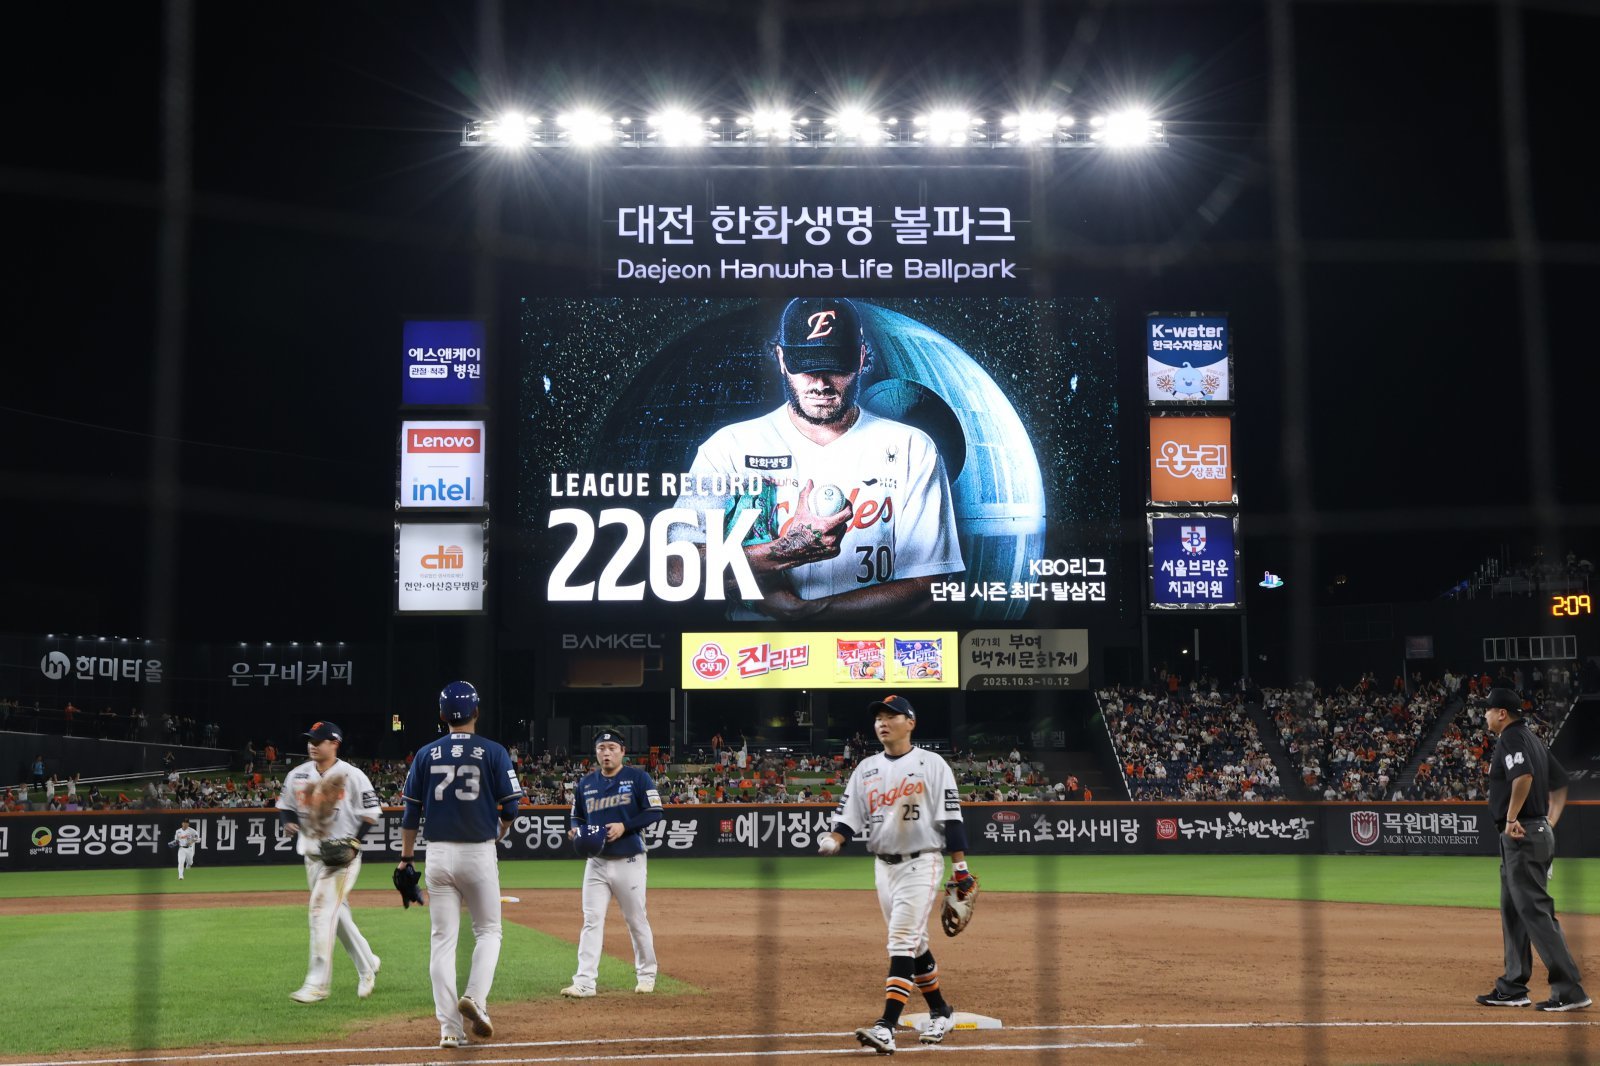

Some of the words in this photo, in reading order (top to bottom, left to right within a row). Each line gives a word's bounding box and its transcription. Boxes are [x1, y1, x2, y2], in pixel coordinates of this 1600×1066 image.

[617, 204, 694, 245] 대전
[710, 204, 873, 246] 한화생명
[891, 205, 1016, 245] 볼파크
[617, 258, 711, 283] Daejeon
[720, 258, 834, 279] Hanwha
[842, 258, 893, 279] Life
[904, 258, 1017, 283] Ballpark
[1151, 324, 1224, 338] K-water
[408, 347, 481, 364] 에스앤케이
[1152, 339, 1224, 351] 한국수자원공사
[453, 363, 481, 379] 병원
[413, 433, 475, 448] Lenovo
[748, 456, 789, 468] 한화생명
[412, 476, 471, 501] intel
[550, 472, 650, 497] LEAGUE
[661, 472, 763, 496] RECORD
[547, 507, 765, 602] 226K
[856, 545, 892, 583] 30
[1029, 557, 1107, 577] KBO리그
[1160, 559, 1229, 577] 서울브라운
[930, 581, 966, 602] 단일
[970, 581, 1008, 602] 시즌
[1010, 581, 1047, 602] 최다
[1051, 581, 1107, 602] 탈삼진
[1168, 580, 1223, 598] 치과의원
[1552, 594, 1591, 617] 2:09
[562, 633, 662, 649] BAMKEL
[970, 636, 1000, 647] 제71회
[1008, 633, 1042, 650] 부여
[75, 655, 164, 683] 한미타올
[736, 642, 809, 679] 진라면
[971, 650, 1078, 669] 백제문화제
[228, 660, 353, 686] 은구비커피
[430, 764, 481, 801] 73
[868, 777, 925, 815] Eagles
[902, 804, 920, 821] 25
[1382, 812, 1480, 835] 목원대학교
[56, 823, 161, 855] 음성명작
[513, 815, 567, 850] 영동
[1383, 835, 1427, 845] MOKWON
[1428, 835, 1480, 845] UNIVERSITY
